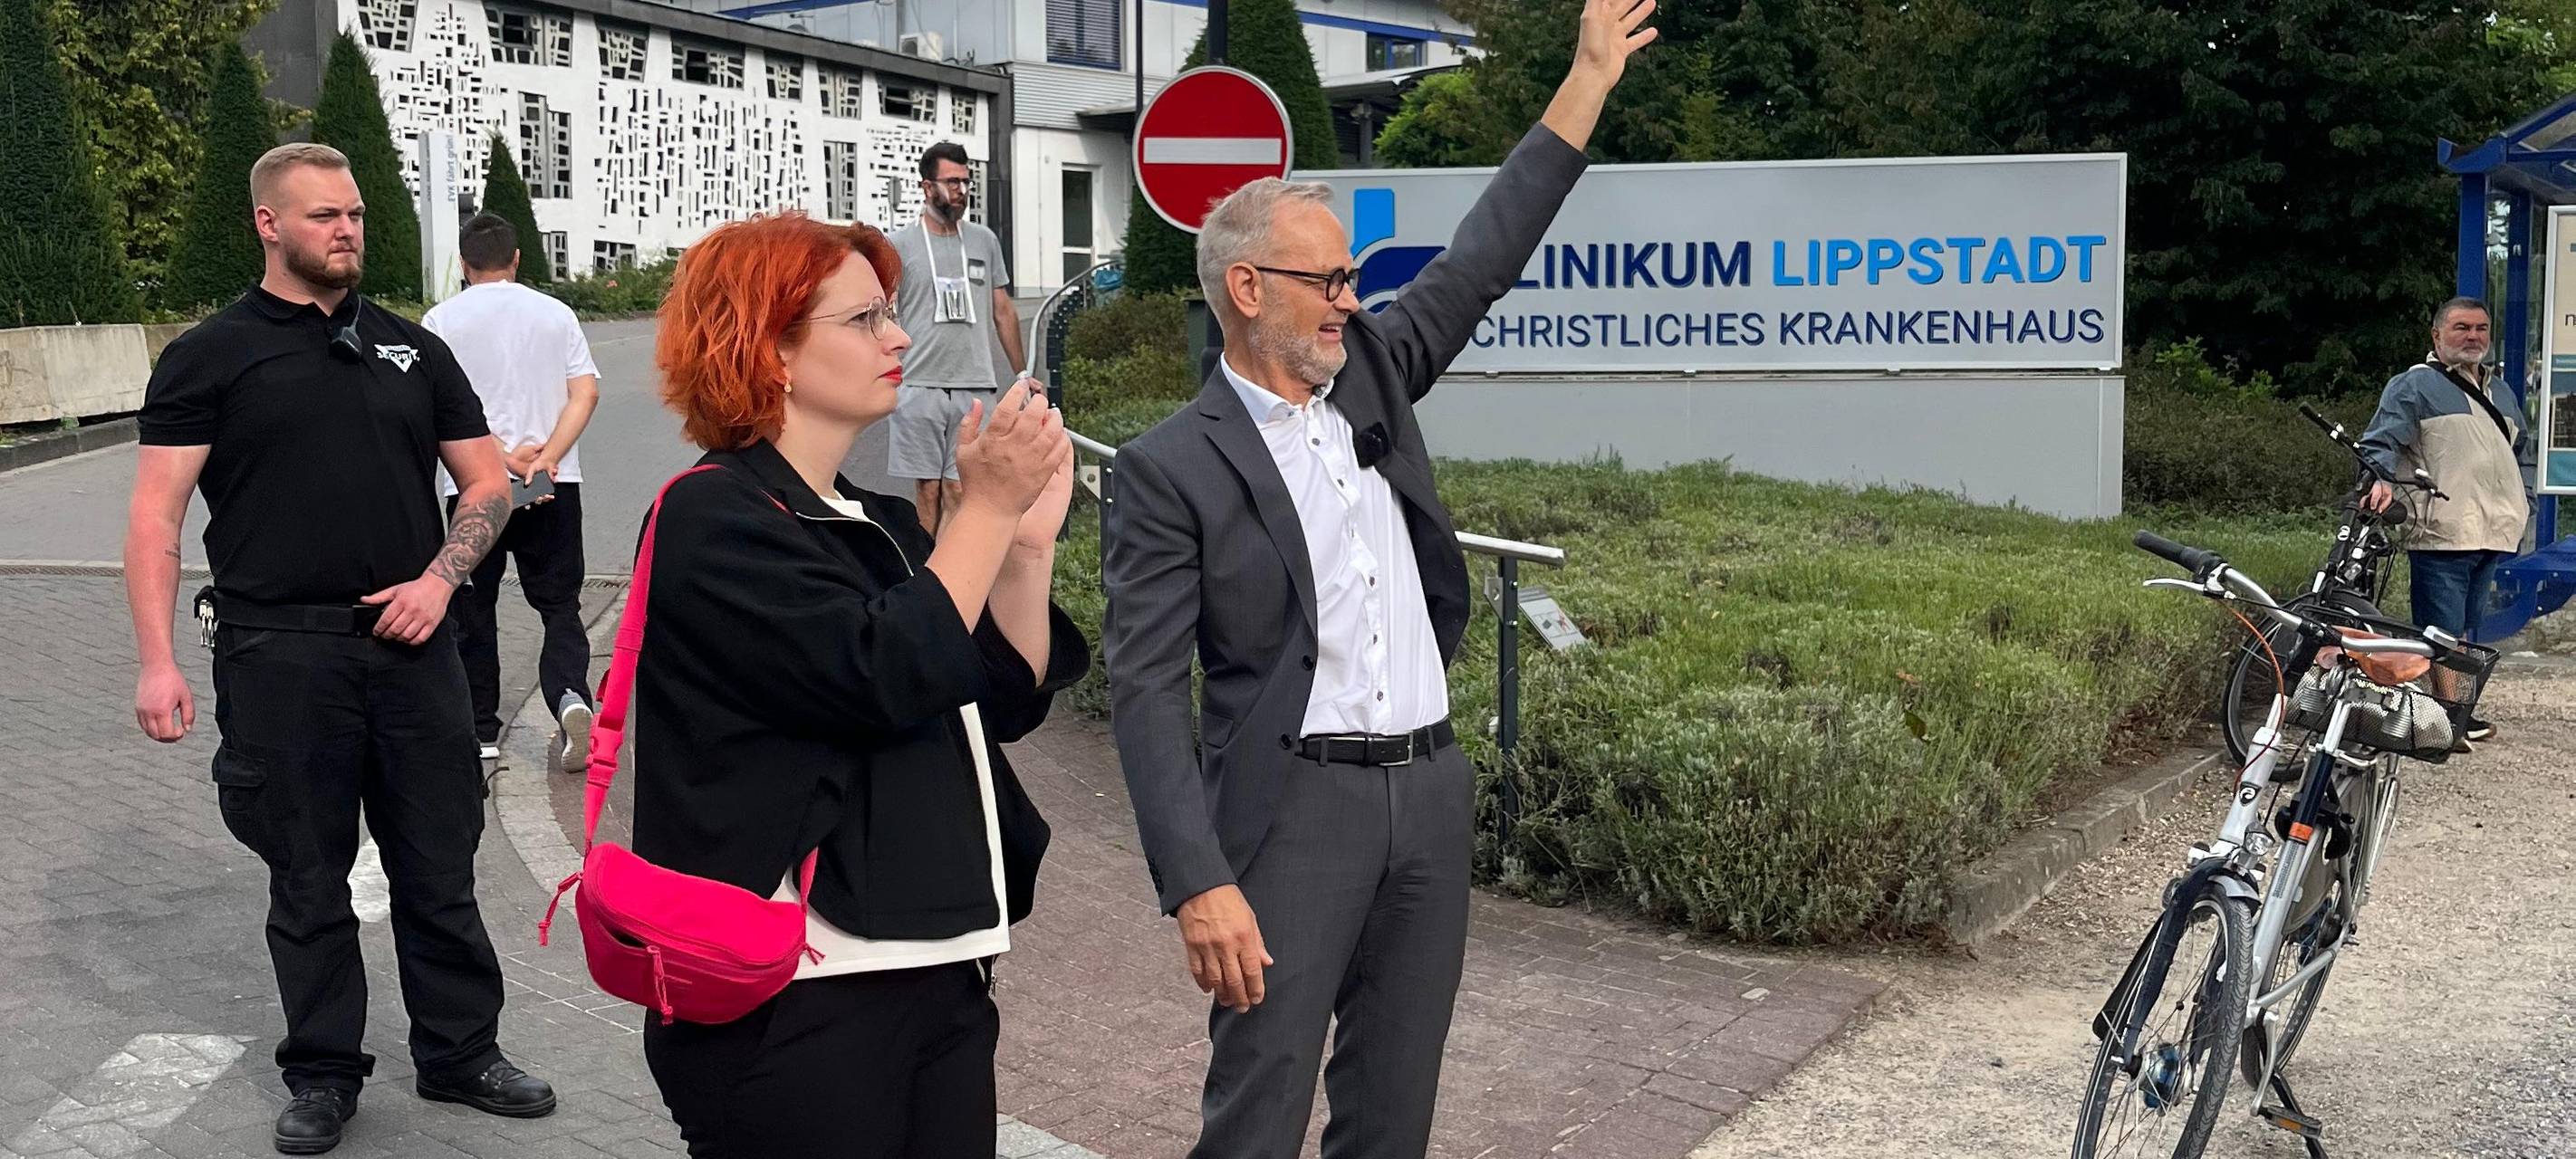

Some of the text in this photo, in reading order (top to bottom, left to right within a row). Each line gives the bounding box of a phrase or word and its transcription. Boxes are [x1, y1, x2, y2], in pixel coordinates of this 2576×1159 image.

[1514, 235, 2107, 290] INIKUM LIPPSTADT
[1472, 309, 2105, 349] CHRISTLICHES KRANKENHAUS
